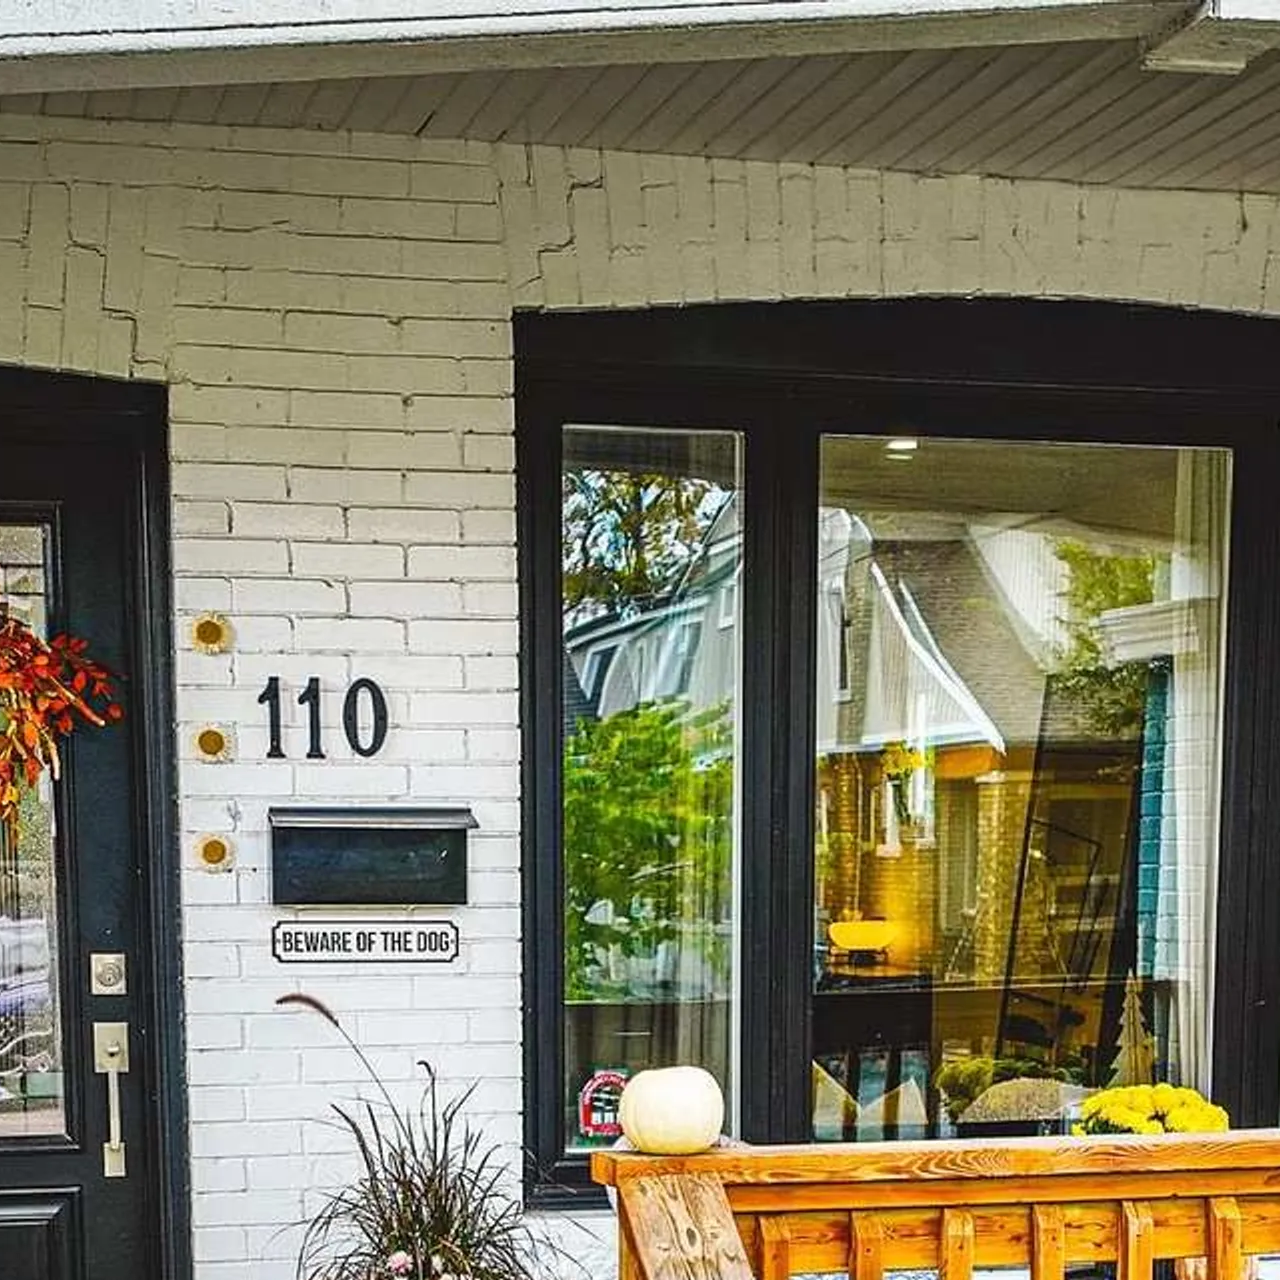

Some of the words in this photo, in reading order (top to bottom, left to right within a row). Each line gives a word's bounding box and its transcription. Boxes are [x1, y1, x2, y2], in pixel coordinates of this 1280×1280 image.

[257, 676, 388, 759] 110
[282, 931, 352, 953] BEWARE
[356, 931, 377, 953] OF
[380, 931, 413, 953] THE
[417, 931, 450, 953] DOG
